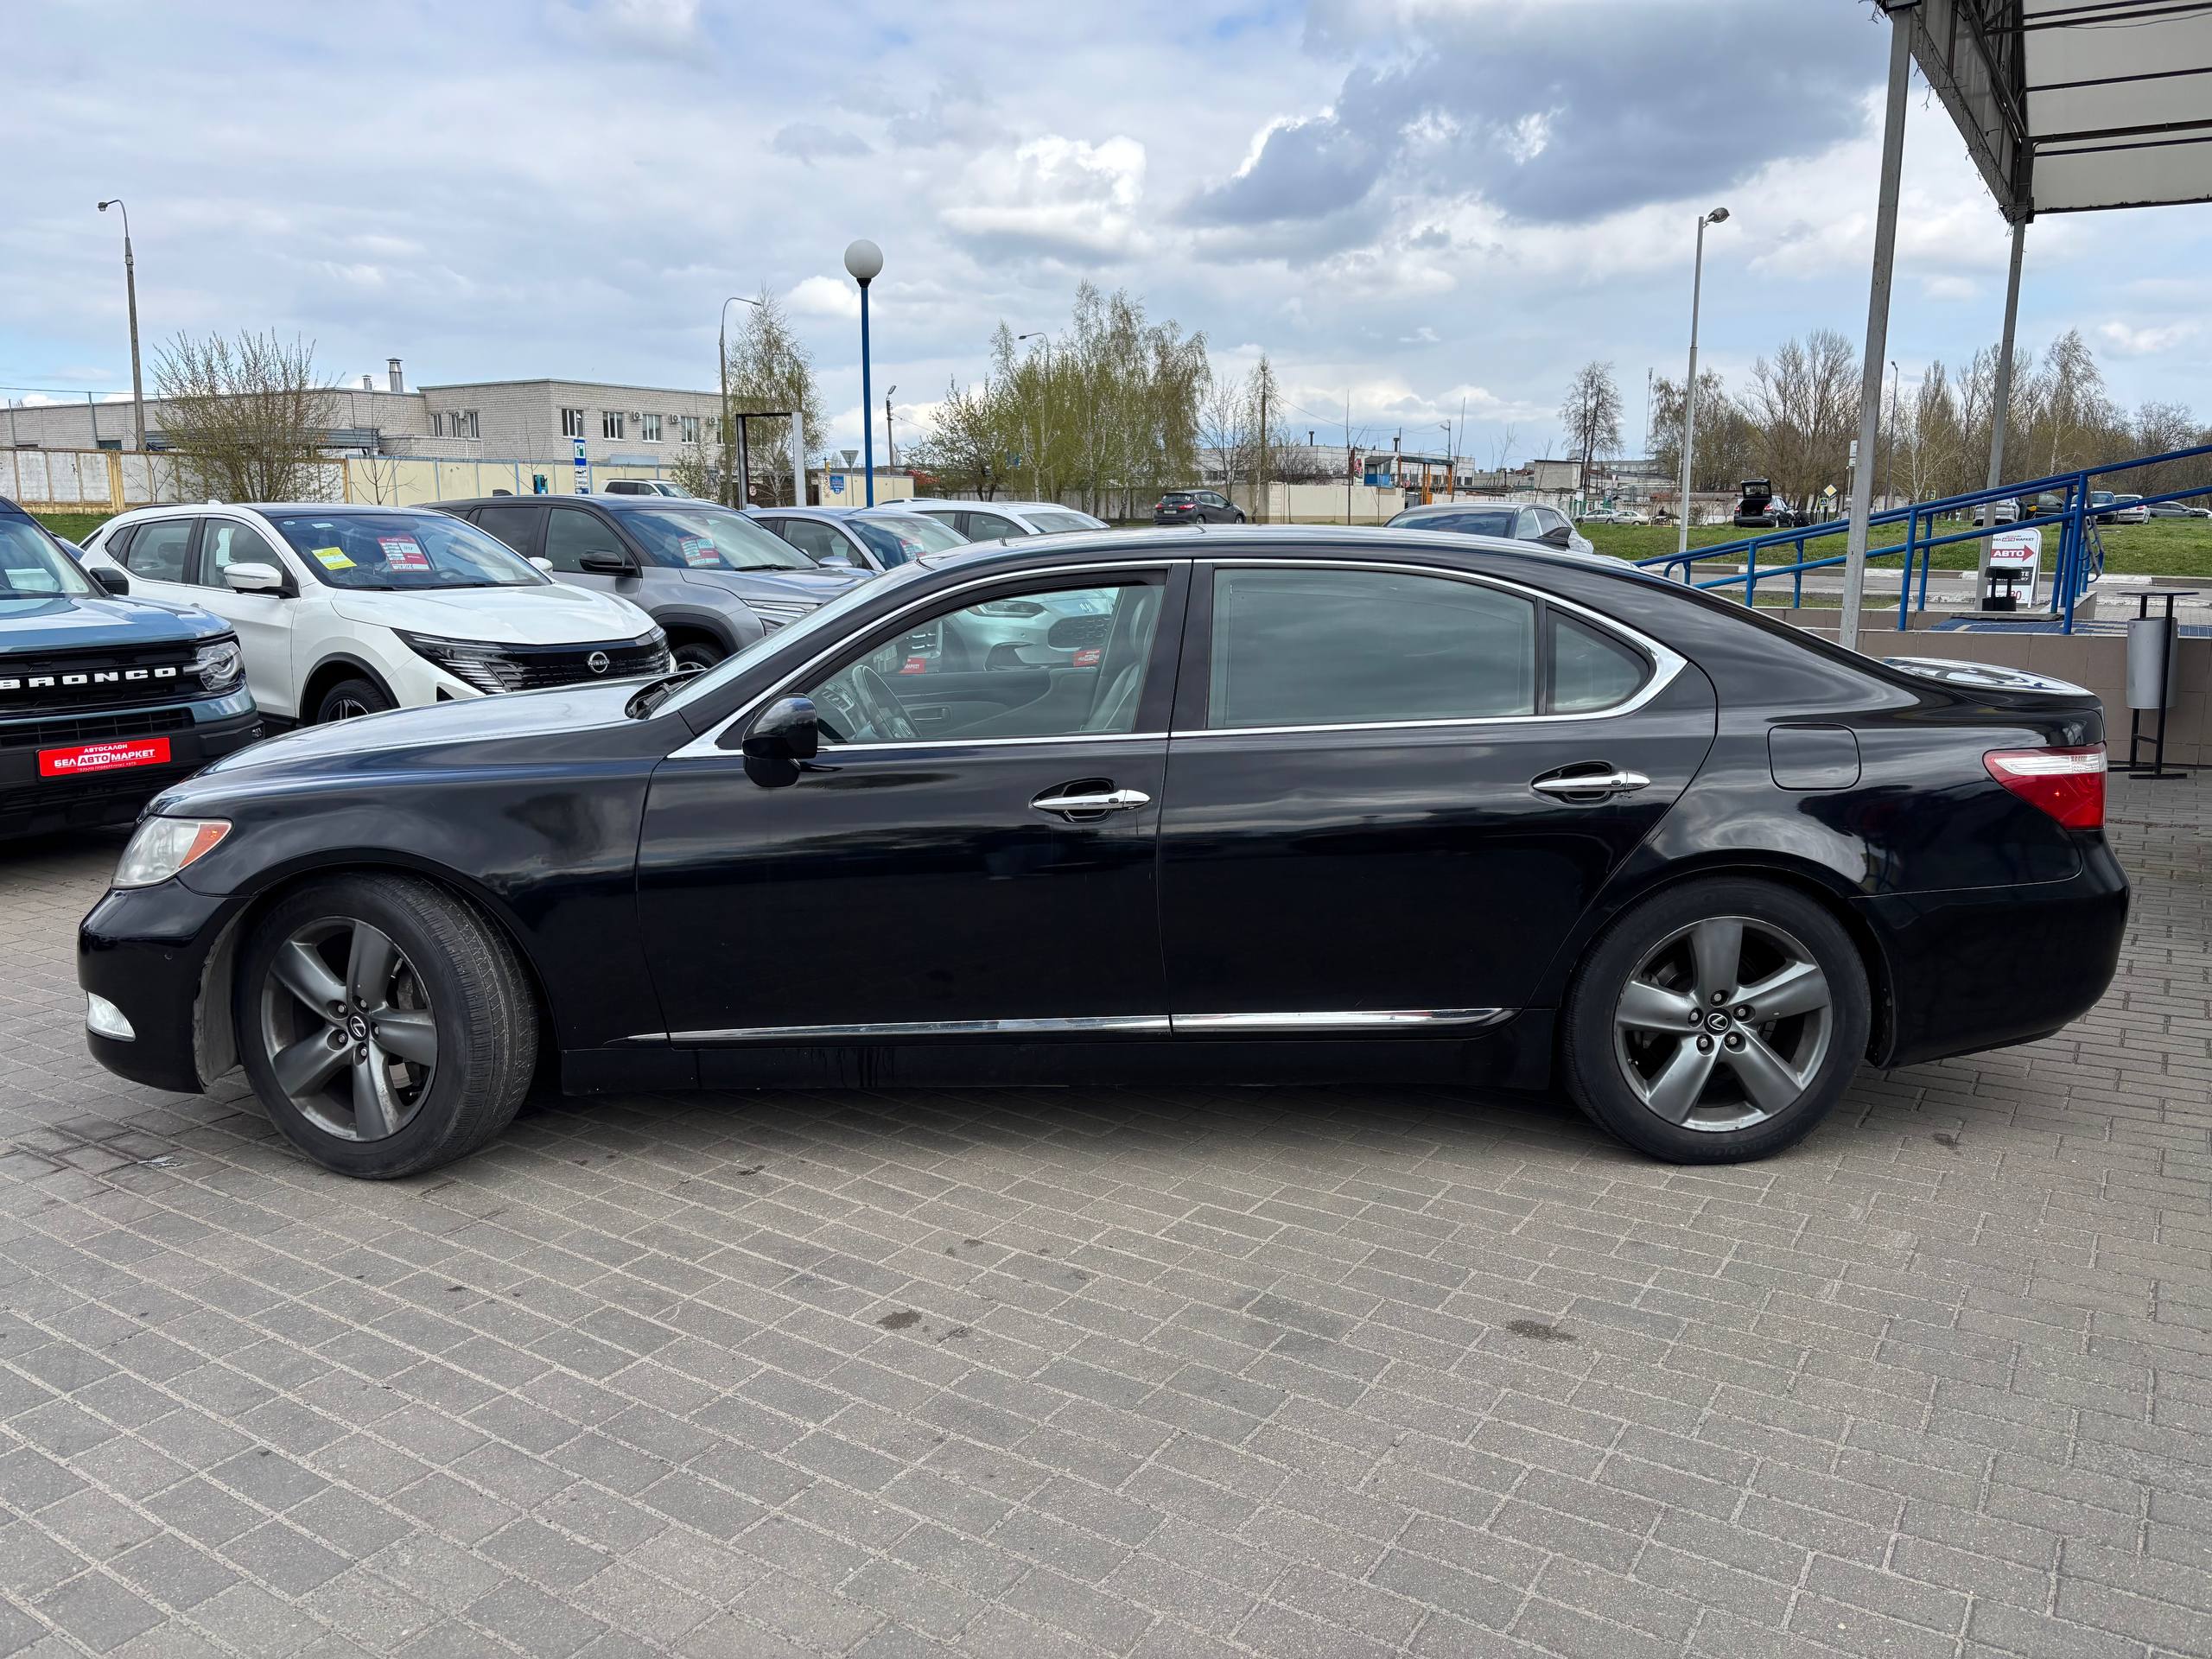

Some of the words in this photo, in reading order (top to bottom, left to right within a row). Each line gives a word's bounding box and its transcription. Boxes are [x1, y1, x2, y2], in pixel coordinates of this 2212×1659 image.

[0, 667, 177, 690] BRONCO
[54, 758, 77, 768] БЕЛ
[79, 754, 109, 765] АВТО
[111, 748, 156, 761] МАРКЕТ
[83, 743, 128, 753] АВТОСАЛОН
